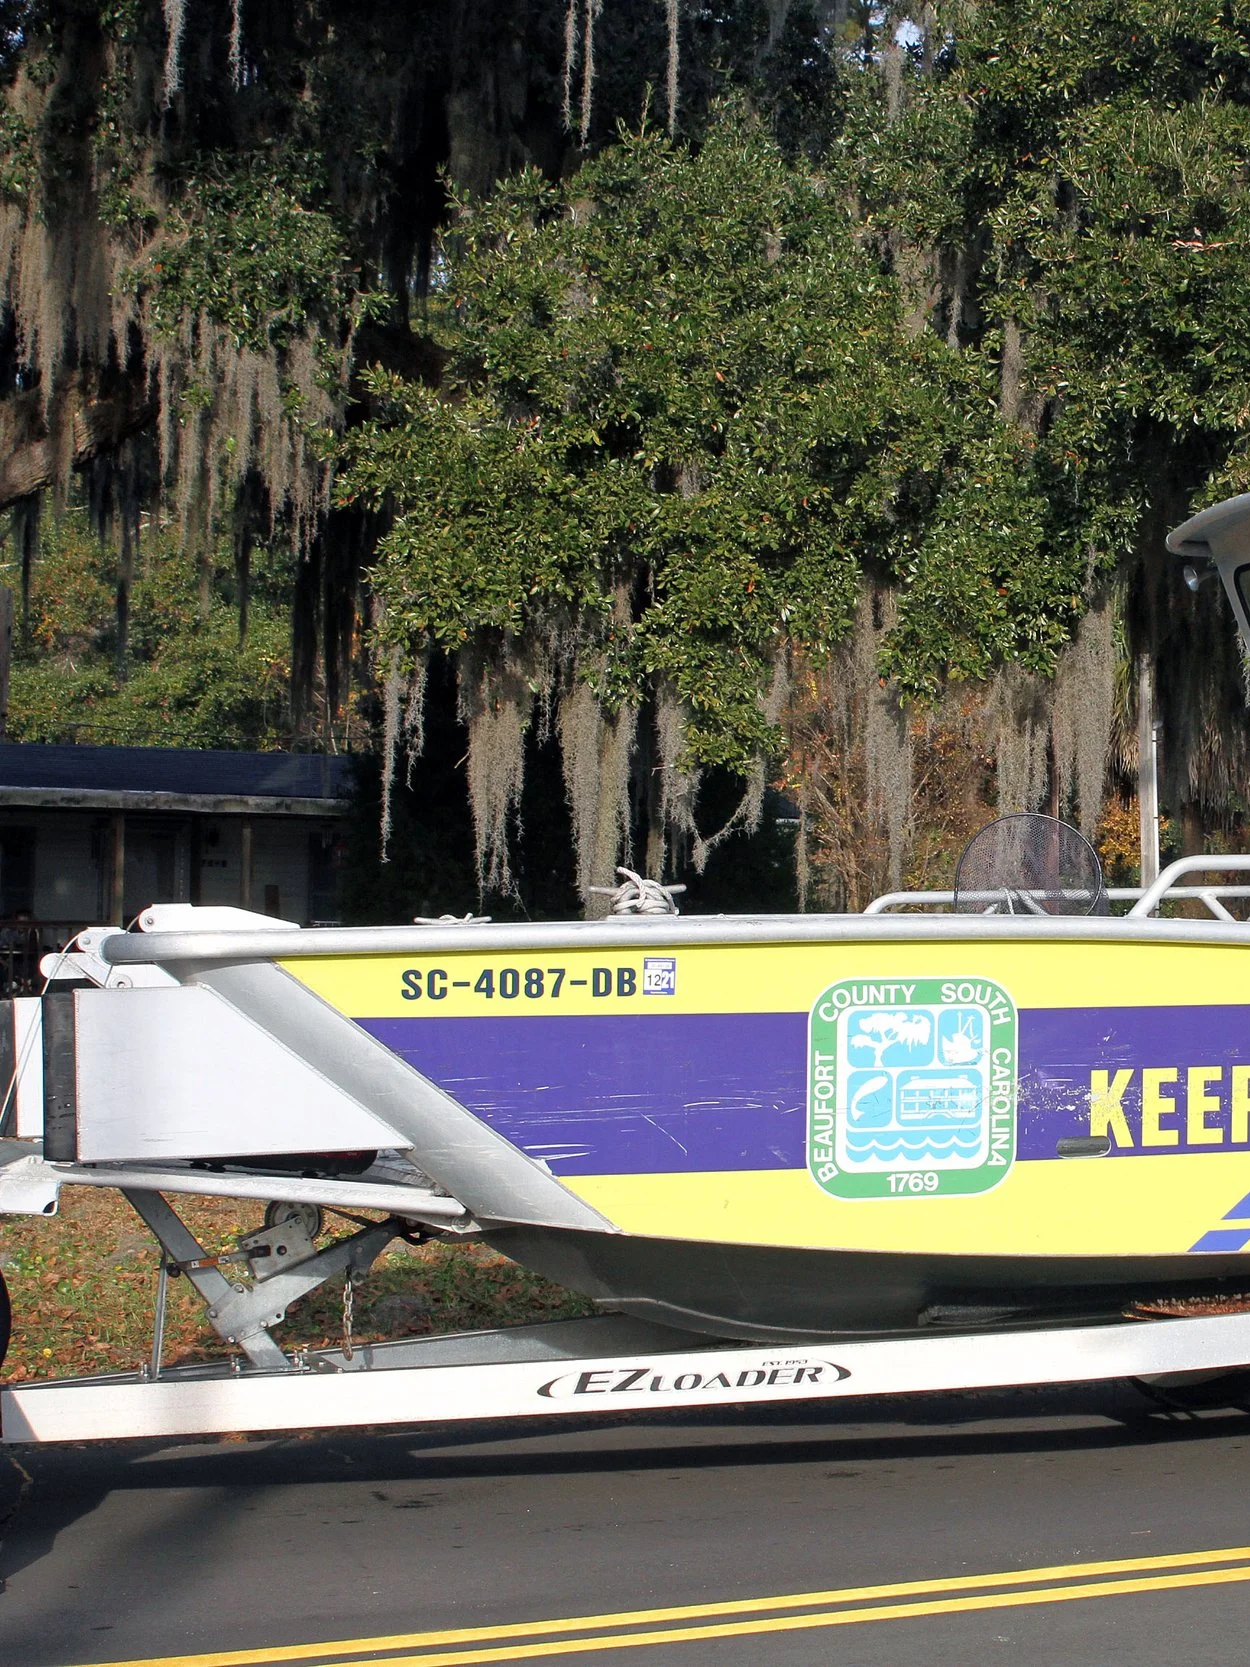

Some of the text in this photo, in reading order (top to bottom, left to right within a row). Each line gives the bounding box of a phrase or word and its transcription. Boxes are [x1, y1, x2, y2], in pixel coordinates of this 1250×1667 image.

[401, 967, 637, 1000] SC-4087-DB
[813, 982, 1012, 1183] BEAUFORT COUNTY SOUTH CAROLINA
[886, 1172, 939, 1192] 1769
